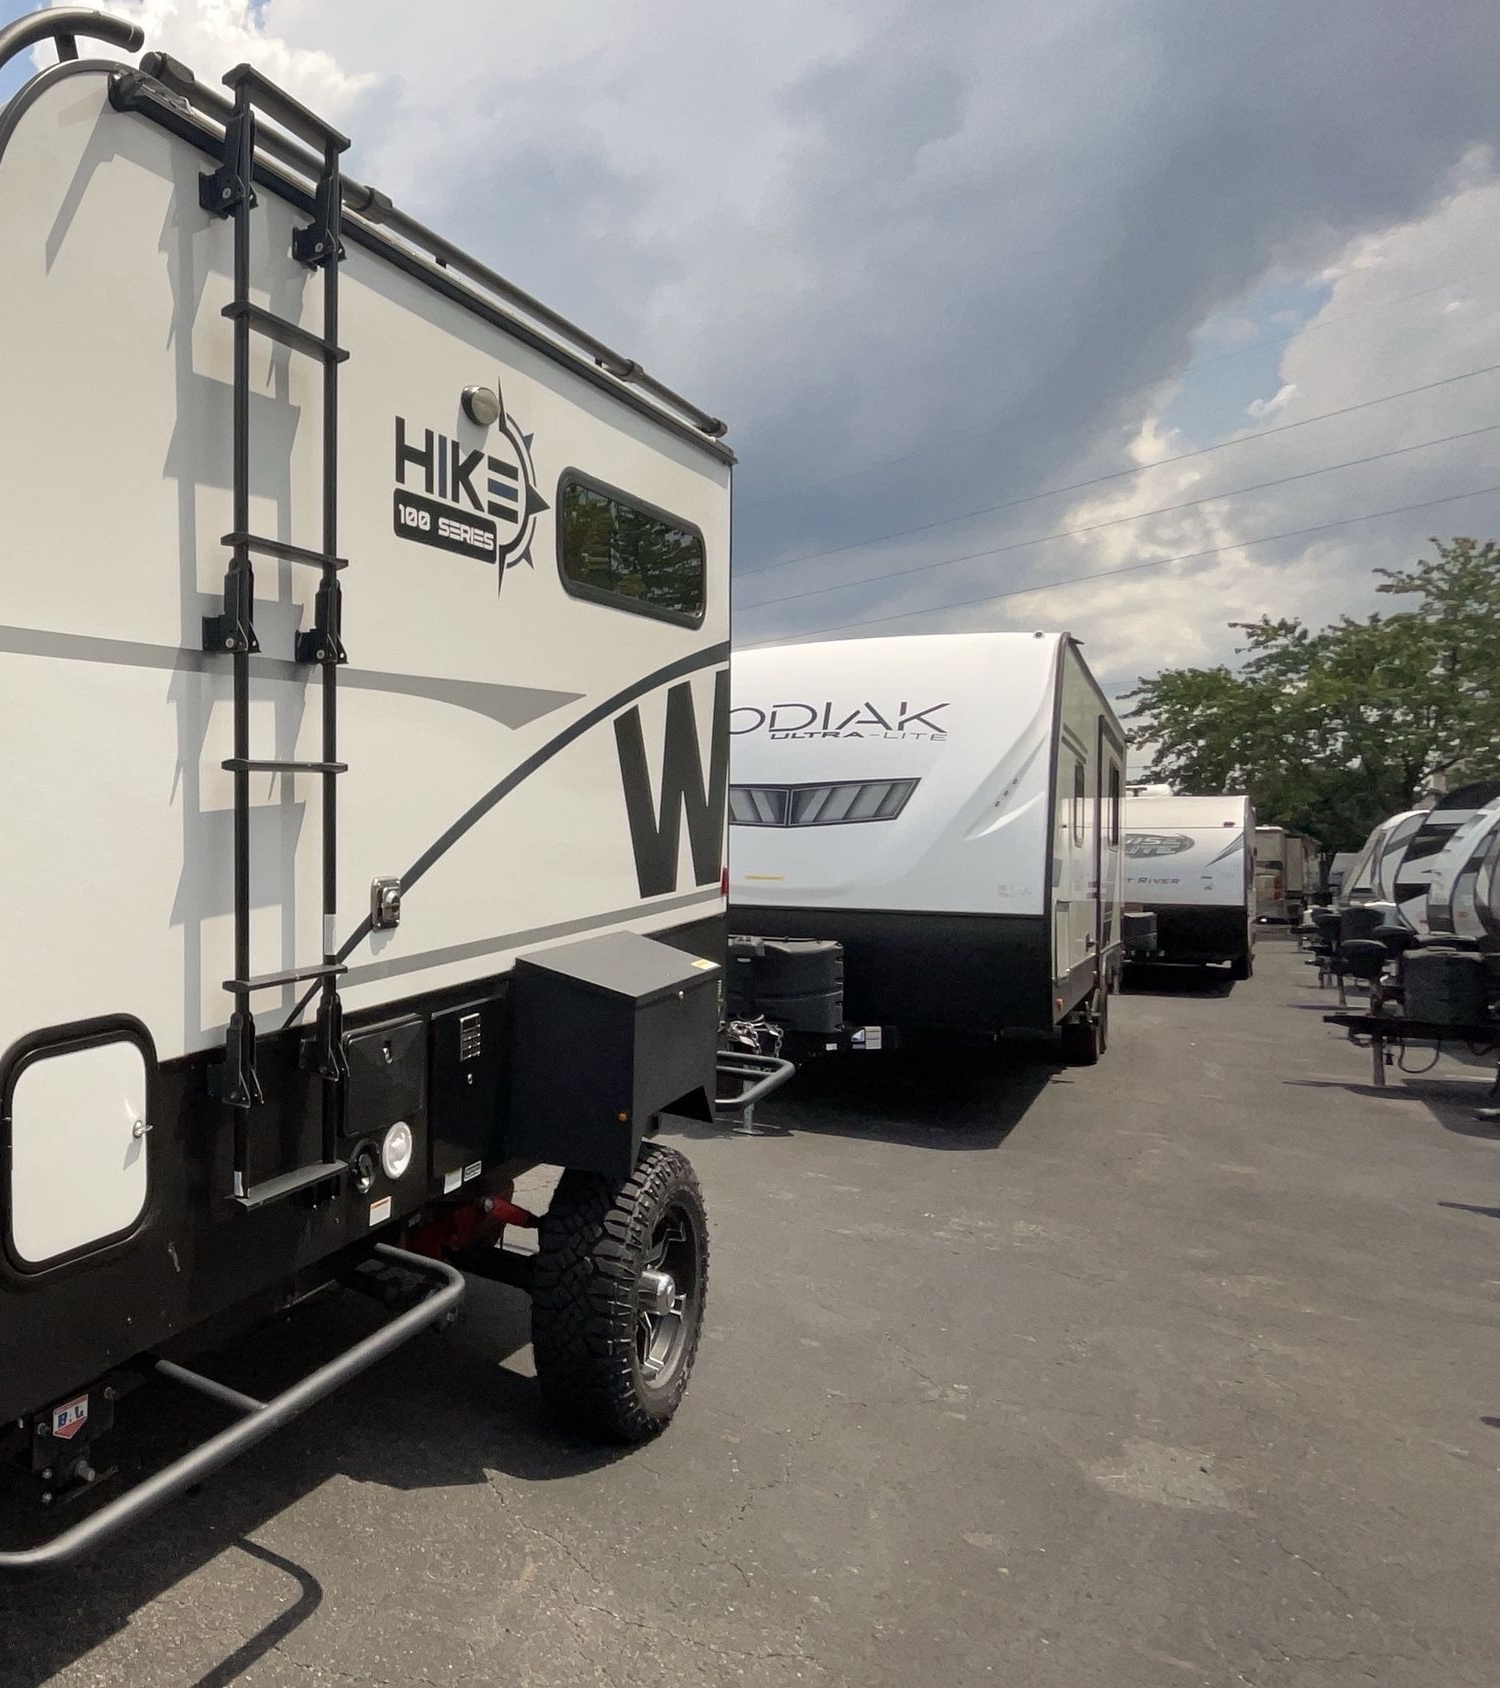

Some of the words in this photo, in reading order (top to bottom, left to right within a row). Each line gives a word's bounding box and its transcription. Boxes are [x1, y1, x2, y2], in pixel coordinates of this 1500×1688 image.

[395, 415, 519, 524] HIKE
[398, 503, 431, 531] 100
[438, 516, 494, 551] SERIES
[729, 701, 951, 735] ODIAK
[770, 731, 948, 742] ULTRA-LITE
[613, 668, 730, 899] W
